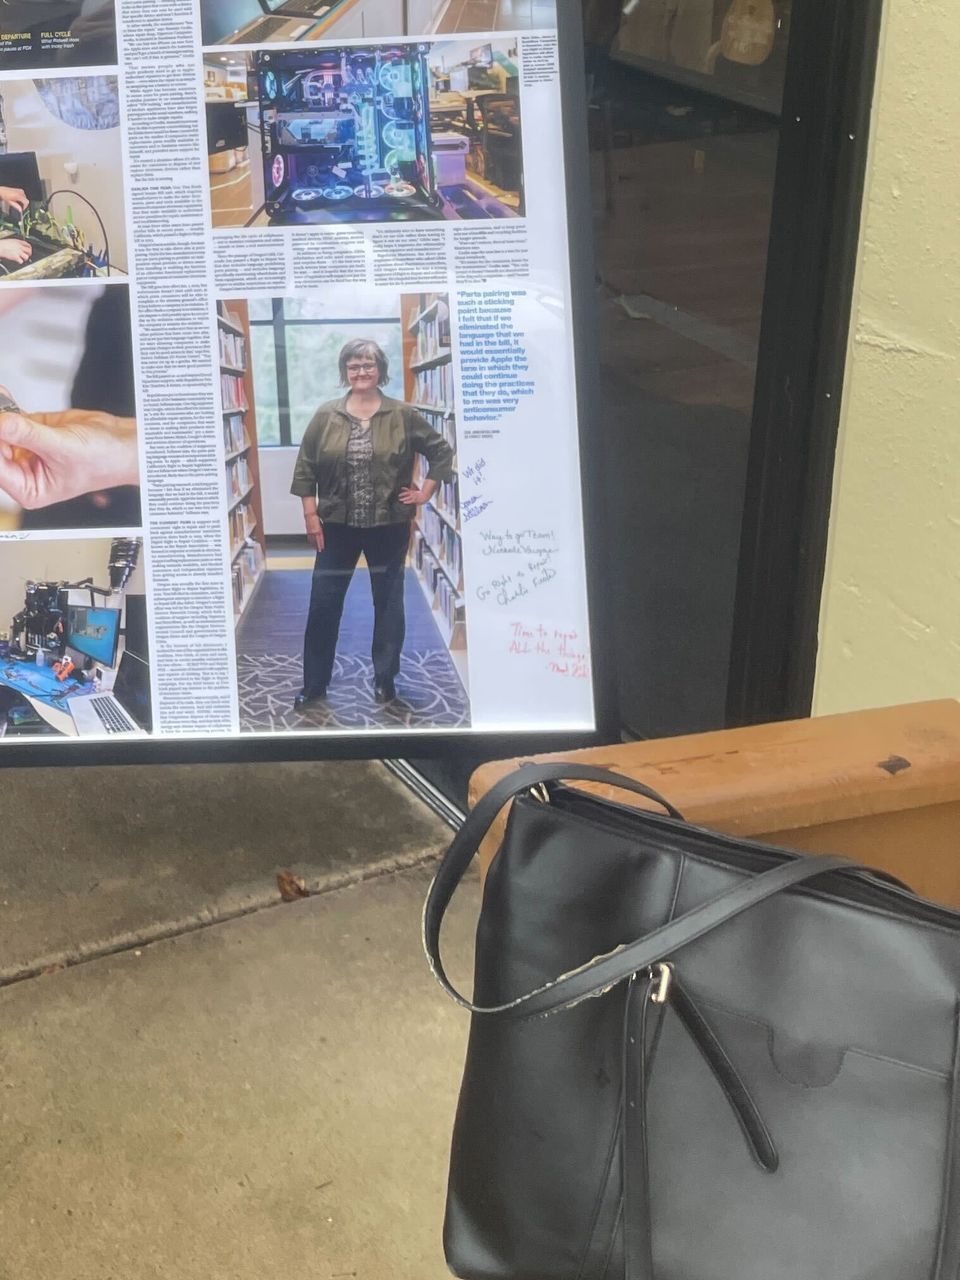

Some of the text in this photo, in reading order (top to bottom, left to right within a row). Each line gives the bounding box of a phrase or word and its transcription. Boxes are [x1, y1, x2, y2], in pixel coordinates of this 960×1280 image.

[459, 332, 495, 340] language
[498, 339, 512, 347] bill,
[484, 347, 525, 355] essentially
[490, 356, 512, 364] Apple
[498, 380, 535, 388] practices
[479, 389, 496, 397] they
